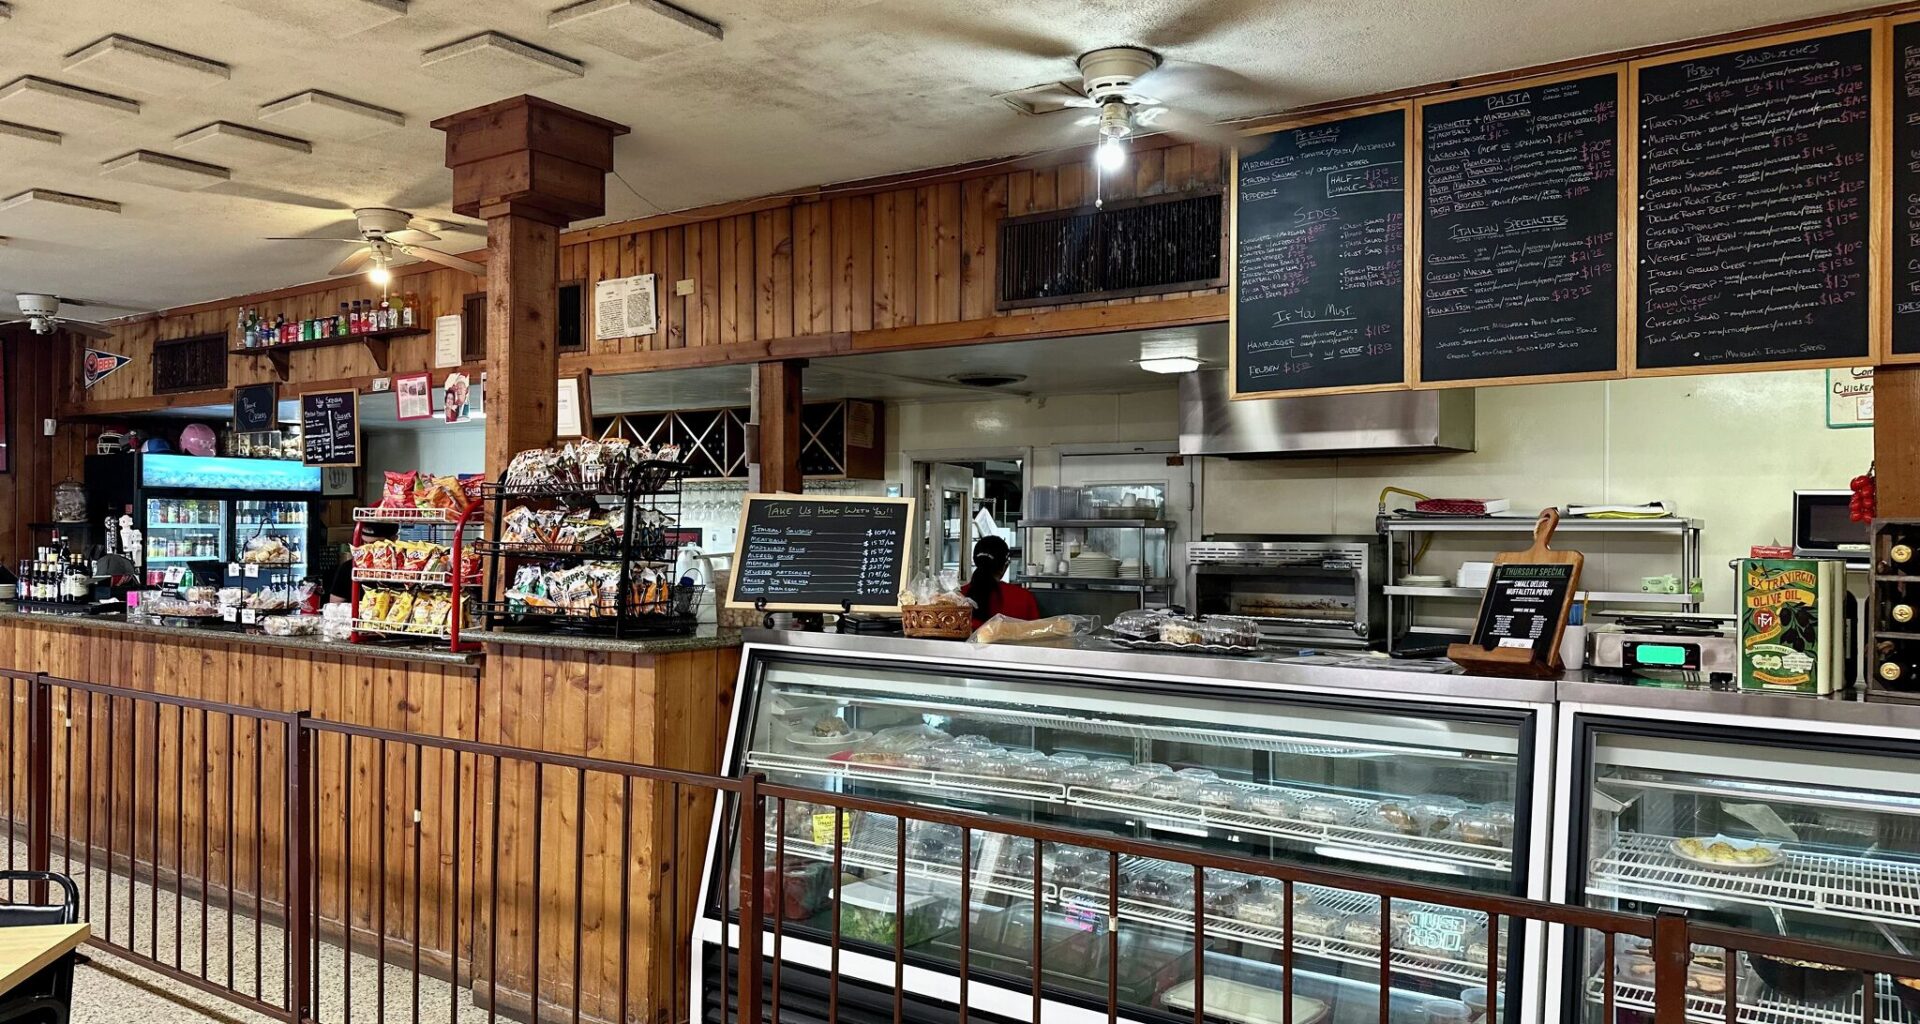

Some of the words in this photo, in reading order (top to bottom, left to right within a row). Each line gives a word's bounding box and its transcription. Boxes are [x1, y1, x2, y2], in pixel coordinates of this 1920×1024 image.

[1734, 43, 1821, 68] SANDWICHES
[1487, 91, 1532, 110] PASTA
[1644, 91, 1681, 105] DELUXE
[1483, 109, 1532, 123] MARINARA
[1645, 116, 1679, 130] TURKEY
[1680, 112, 1712, 125] DELUXE
[1647, 148, 1680, 159] TURKEY
[1241, 154, 1295, 171] MARGHERITA
[1649, 159, 1695, 174] MEATBALL
[1330, 173, 1353, 185] HALF
[1647, 175, 1682, 187] ITALIAN
[1328, 182, 1360, 194] WHOLE
[1646, 189, 1682, 200] CHICKEN
[1646, 201, 1682, 212] ITALIAN
[1681, 195, 1711, 206] ROAST
[1714, 191, 1737, 203] BEEF
[1293, 206, 1338, 224] SIDES
[1707, 205, 1731, 215] BEEF
[1447, 223, 1499, 239] ITALIAN
[1503, 214, 1568, 231] SPECIALTIES
[1645, 226, 1685, 237] CHICKEN
[1646, 236, 1692, 250] EGGPLANT
[1695, 232, 1737, 243] PARMESAN
[1648, 252, 1688, 265] VEGGIE
[1646, 269, 1683, 280] ITALIAN
[1648, 281, 1678, 296] FRIED
[1678, 280, 1718, 292] SHRIMP
[1645, 298, 1679, 313] ITALIAN
[1680, 292, 1721, 306] CHICKEN
[1275, 310, 1292, 322] IF
[1294, 306, 1316, 319] YOU
[1645, 316, 1691, 329] CHICKEN
[1693, 311, 1720, 322] SALAD
[1644, 334, 1667, 345] TUNA
[1670, 331, 1701, 341] SALAD
[764, 502, 793, 517] TAKE
[798, 505, 812, 515] US
[817, 505, 841, 515] HOME
[844, 505, 870, 514] WITH
[1505, 567, 1538, 576] THURSDAY
[1539, 567, 1566, 576] SPECIAL
[1514, 580, 1530, 588] SMALL
[1751, 573, 1785, 589] EXTRA
[1785, 571, 1816, 585] VIRGIN
[1753, 591, 1782, 607] OLIVE
[1785, 589, 1802, 600] OIL
